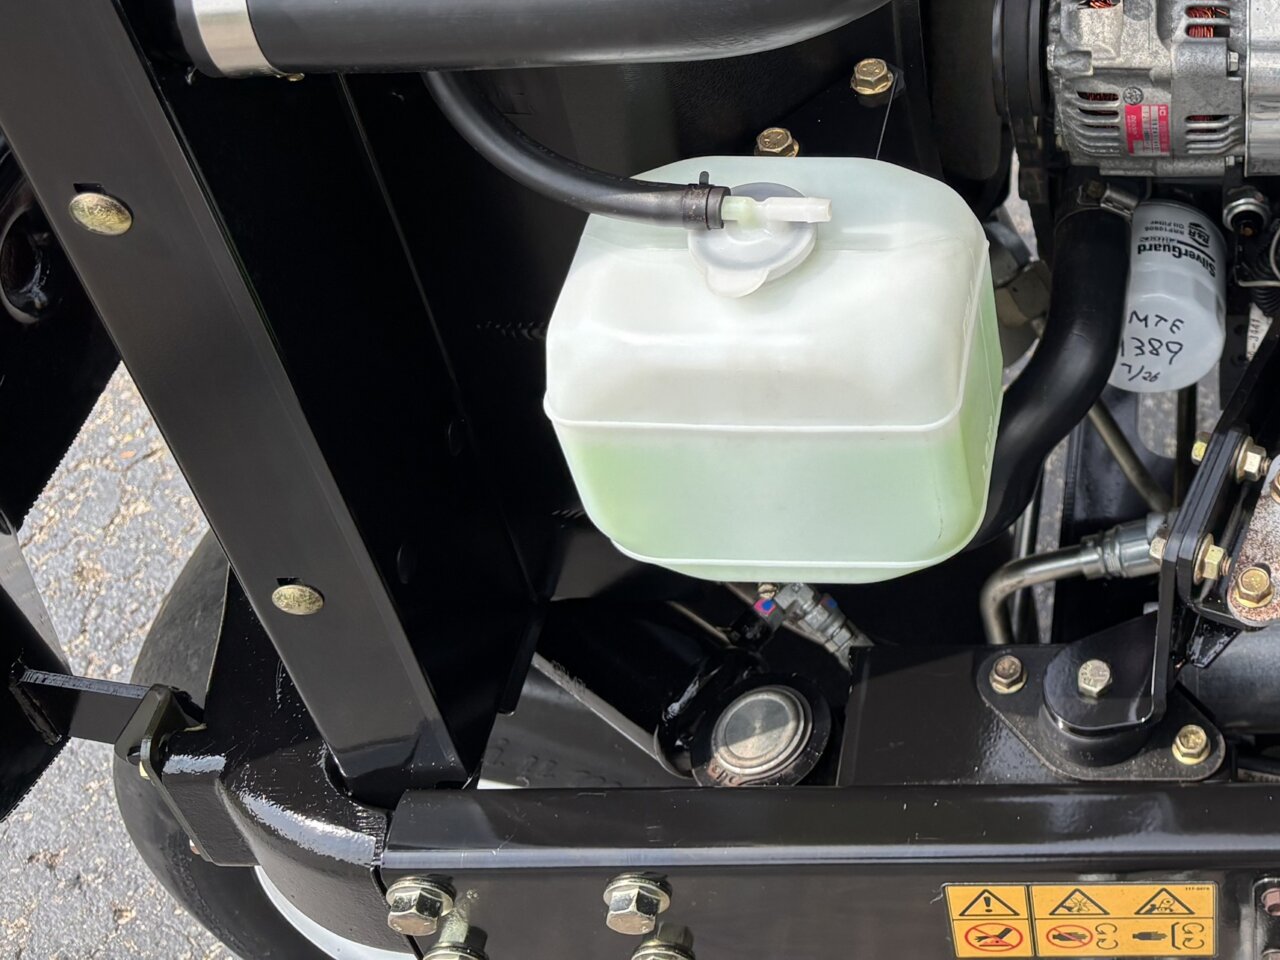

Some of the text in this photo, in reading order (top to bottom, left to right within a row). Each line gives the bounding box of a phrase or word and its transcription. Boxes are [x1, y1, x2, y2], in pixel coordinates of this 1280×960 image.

[1137, 244, 1215, 278] SilverGuard
[1129, 310, 1184, 334] MTE
[1121, 337, 1183, 365] 1389
